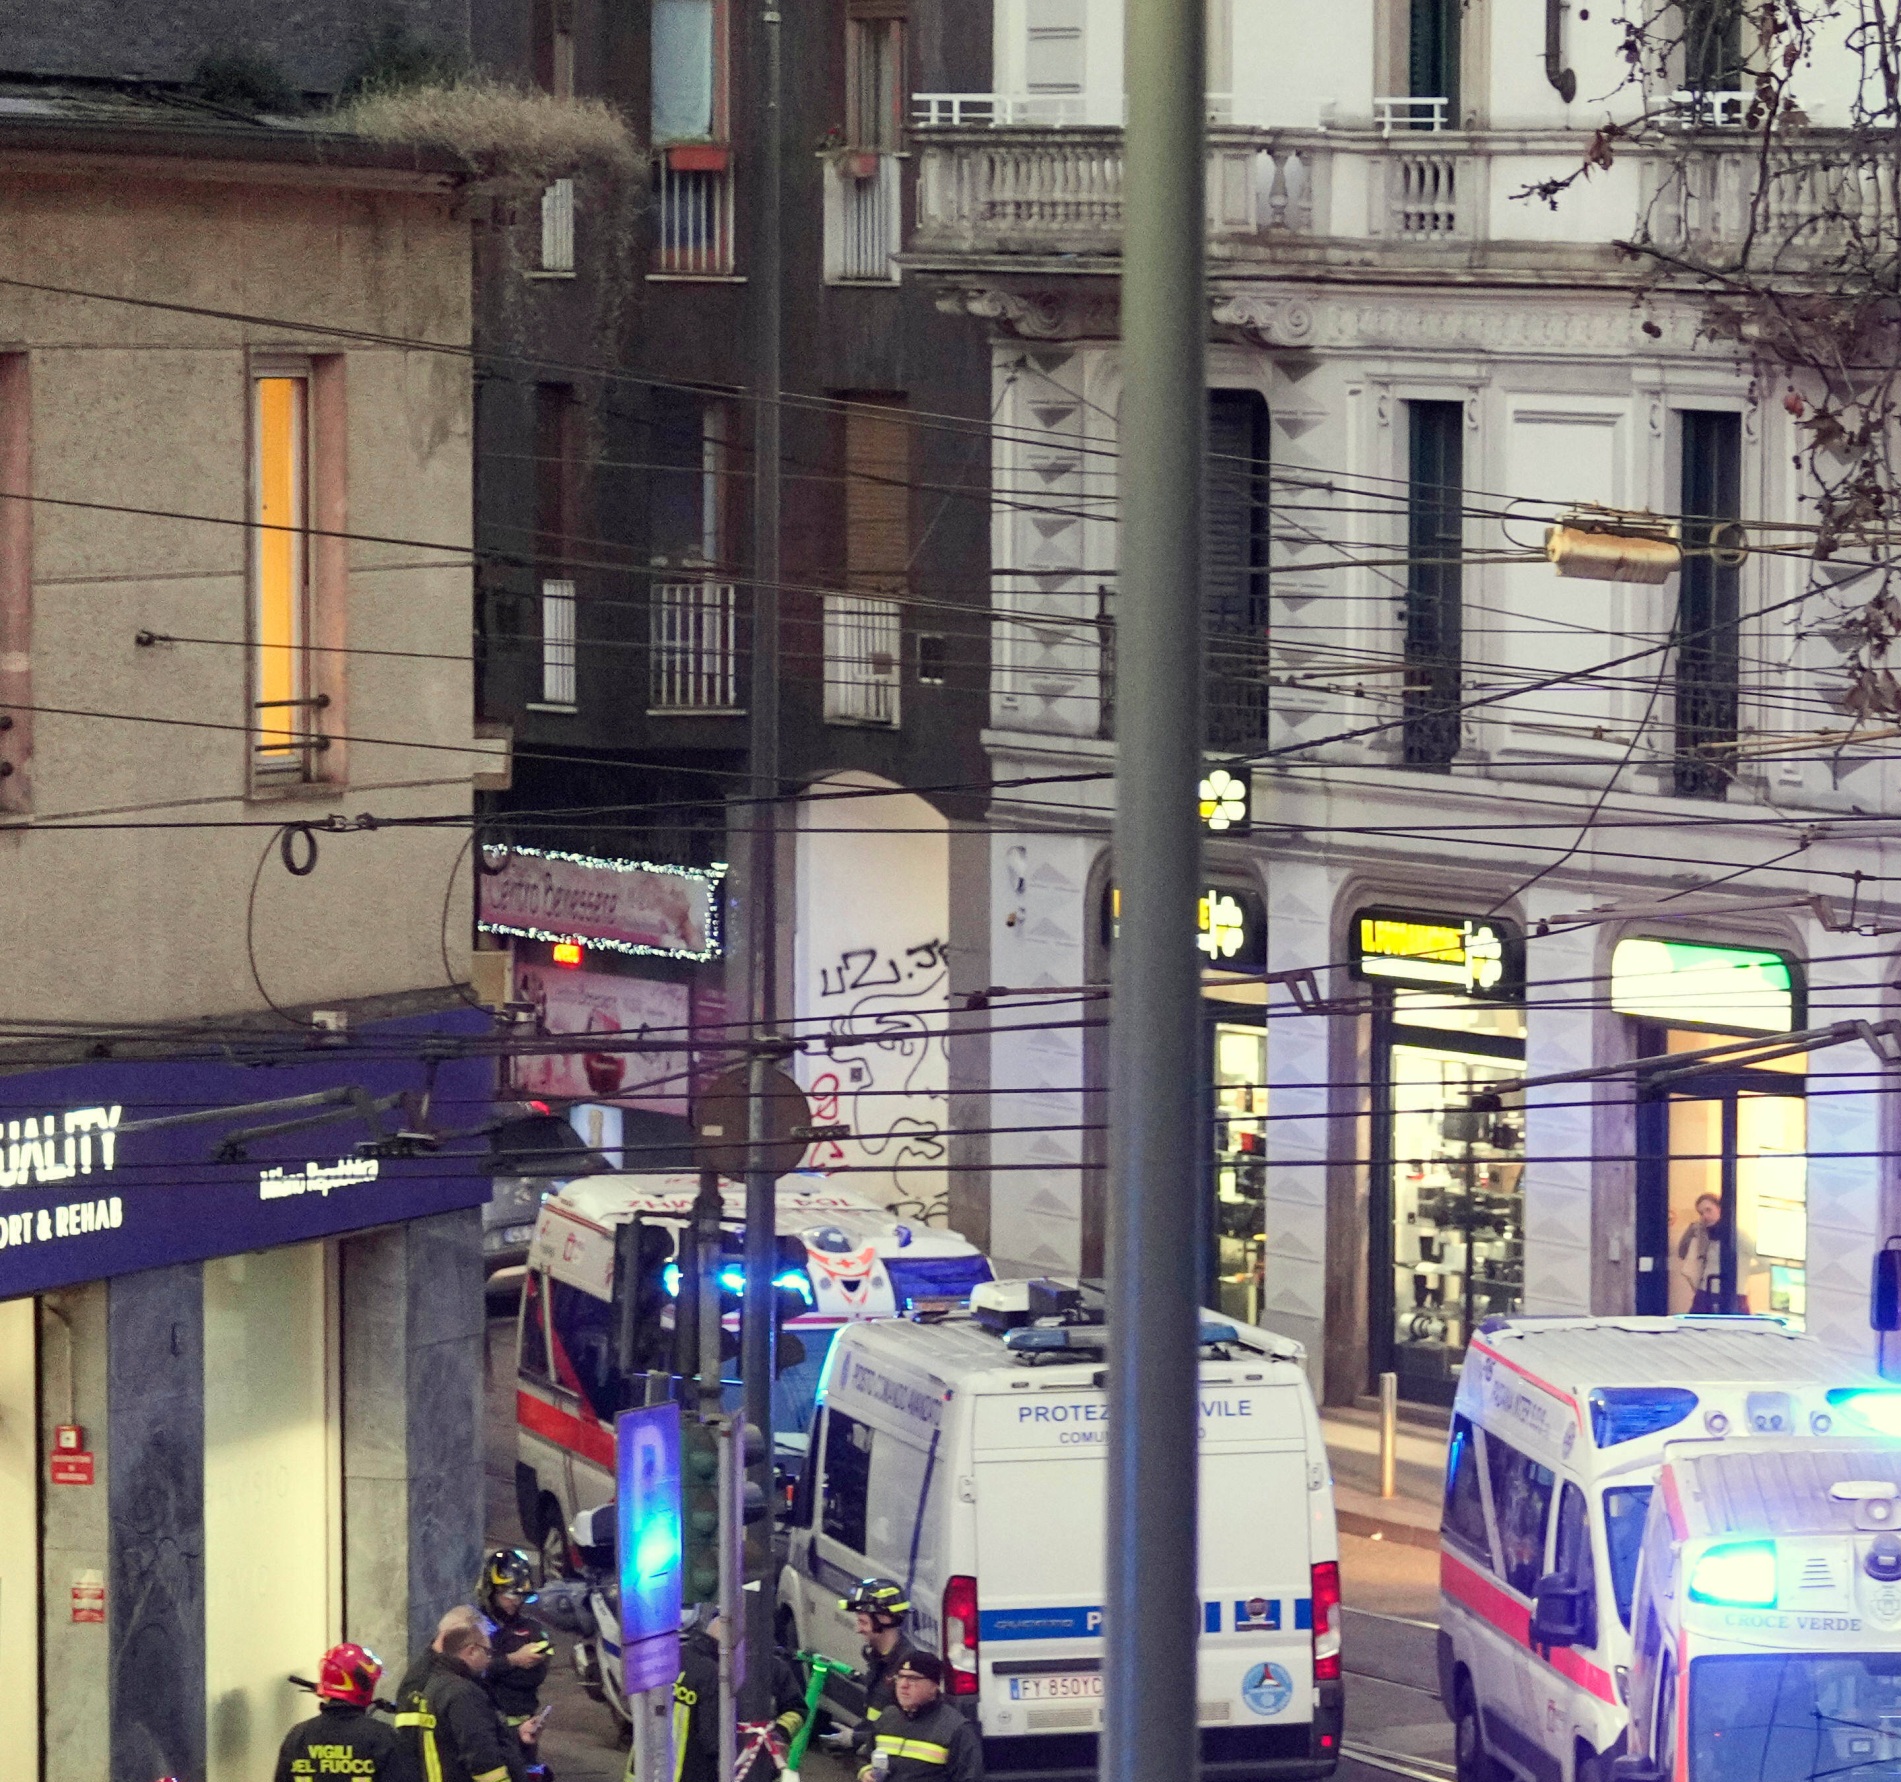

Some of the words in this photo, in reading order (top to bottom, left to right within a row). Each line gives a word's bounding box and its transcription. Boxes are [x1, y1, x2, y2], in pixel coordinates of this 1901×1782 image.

[56, 1196, 122, 1238] REHAB
[1017, 1403, 1109, 1423] PROTEZ
[1201, 1399, 1253, 1418] VILE
[1798, 1617, 1862, 1632] VERDE
[306, 1744, 353, 1761] VIGILI
